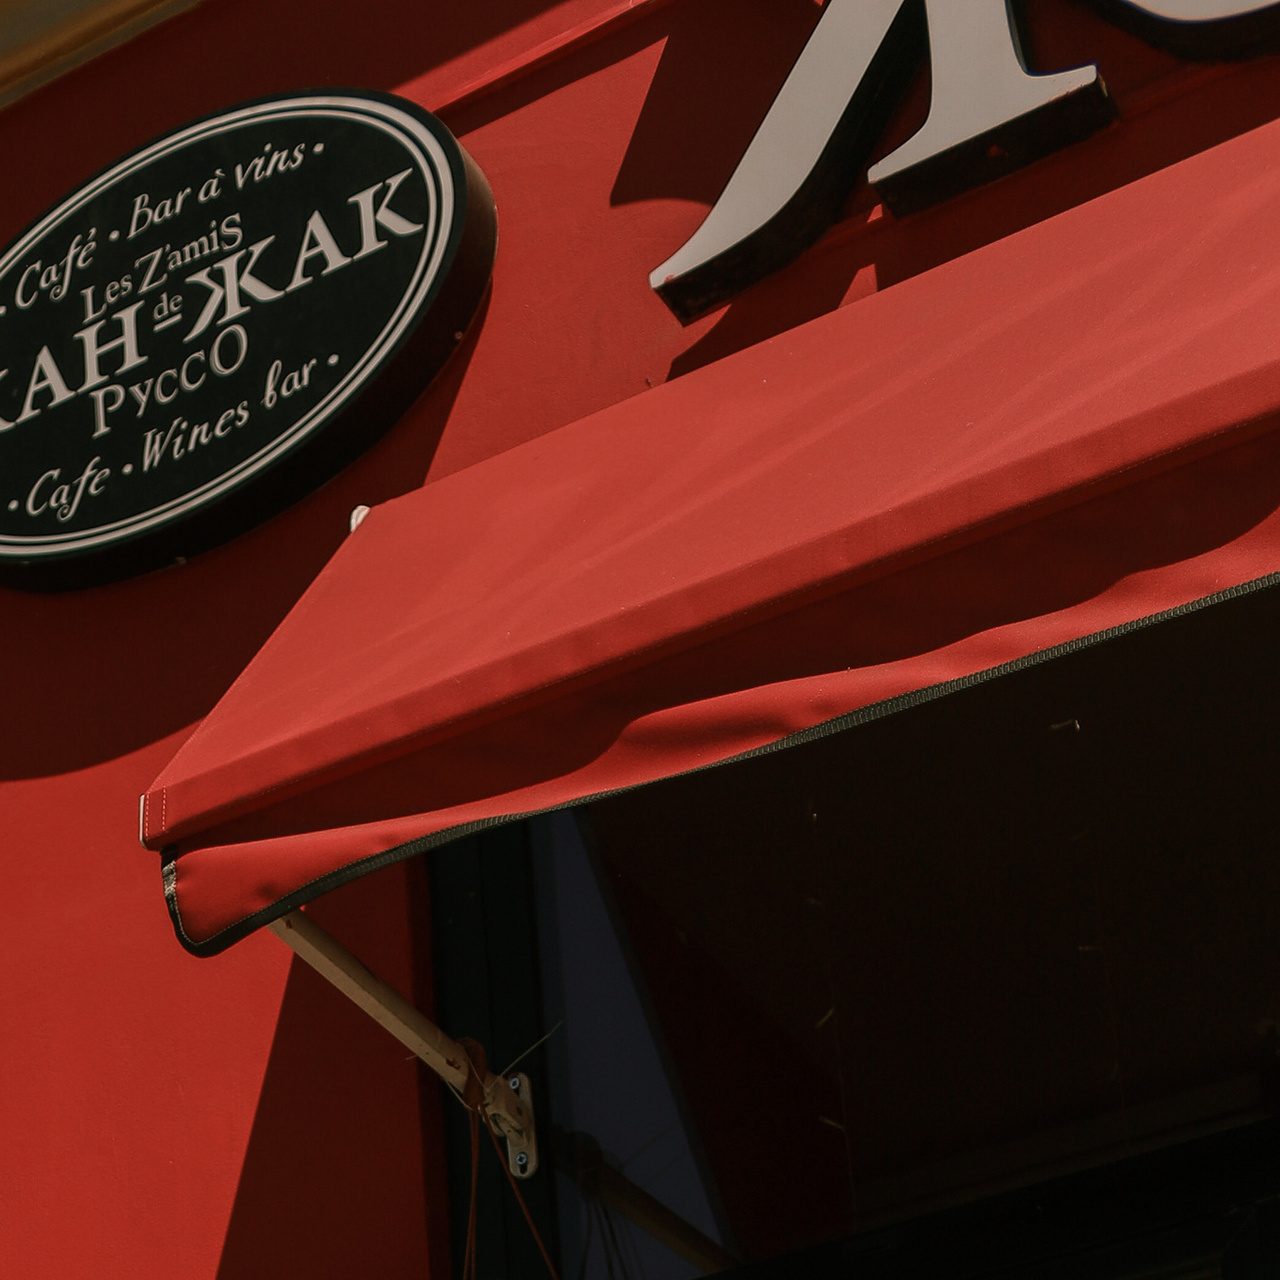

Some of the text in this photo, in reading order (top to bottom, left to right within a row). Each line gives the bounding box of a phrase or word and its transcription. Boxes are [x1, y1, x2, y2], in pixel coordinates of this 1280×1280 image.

[14, 142, 307, 309] Café Bar à vins
[79, 273, 133, 324] Les
[152, 291, 184, 321] de
[182, 167, 424, 344] ЖАК
[25, 358, 318, 524] Cafe Wines bar
